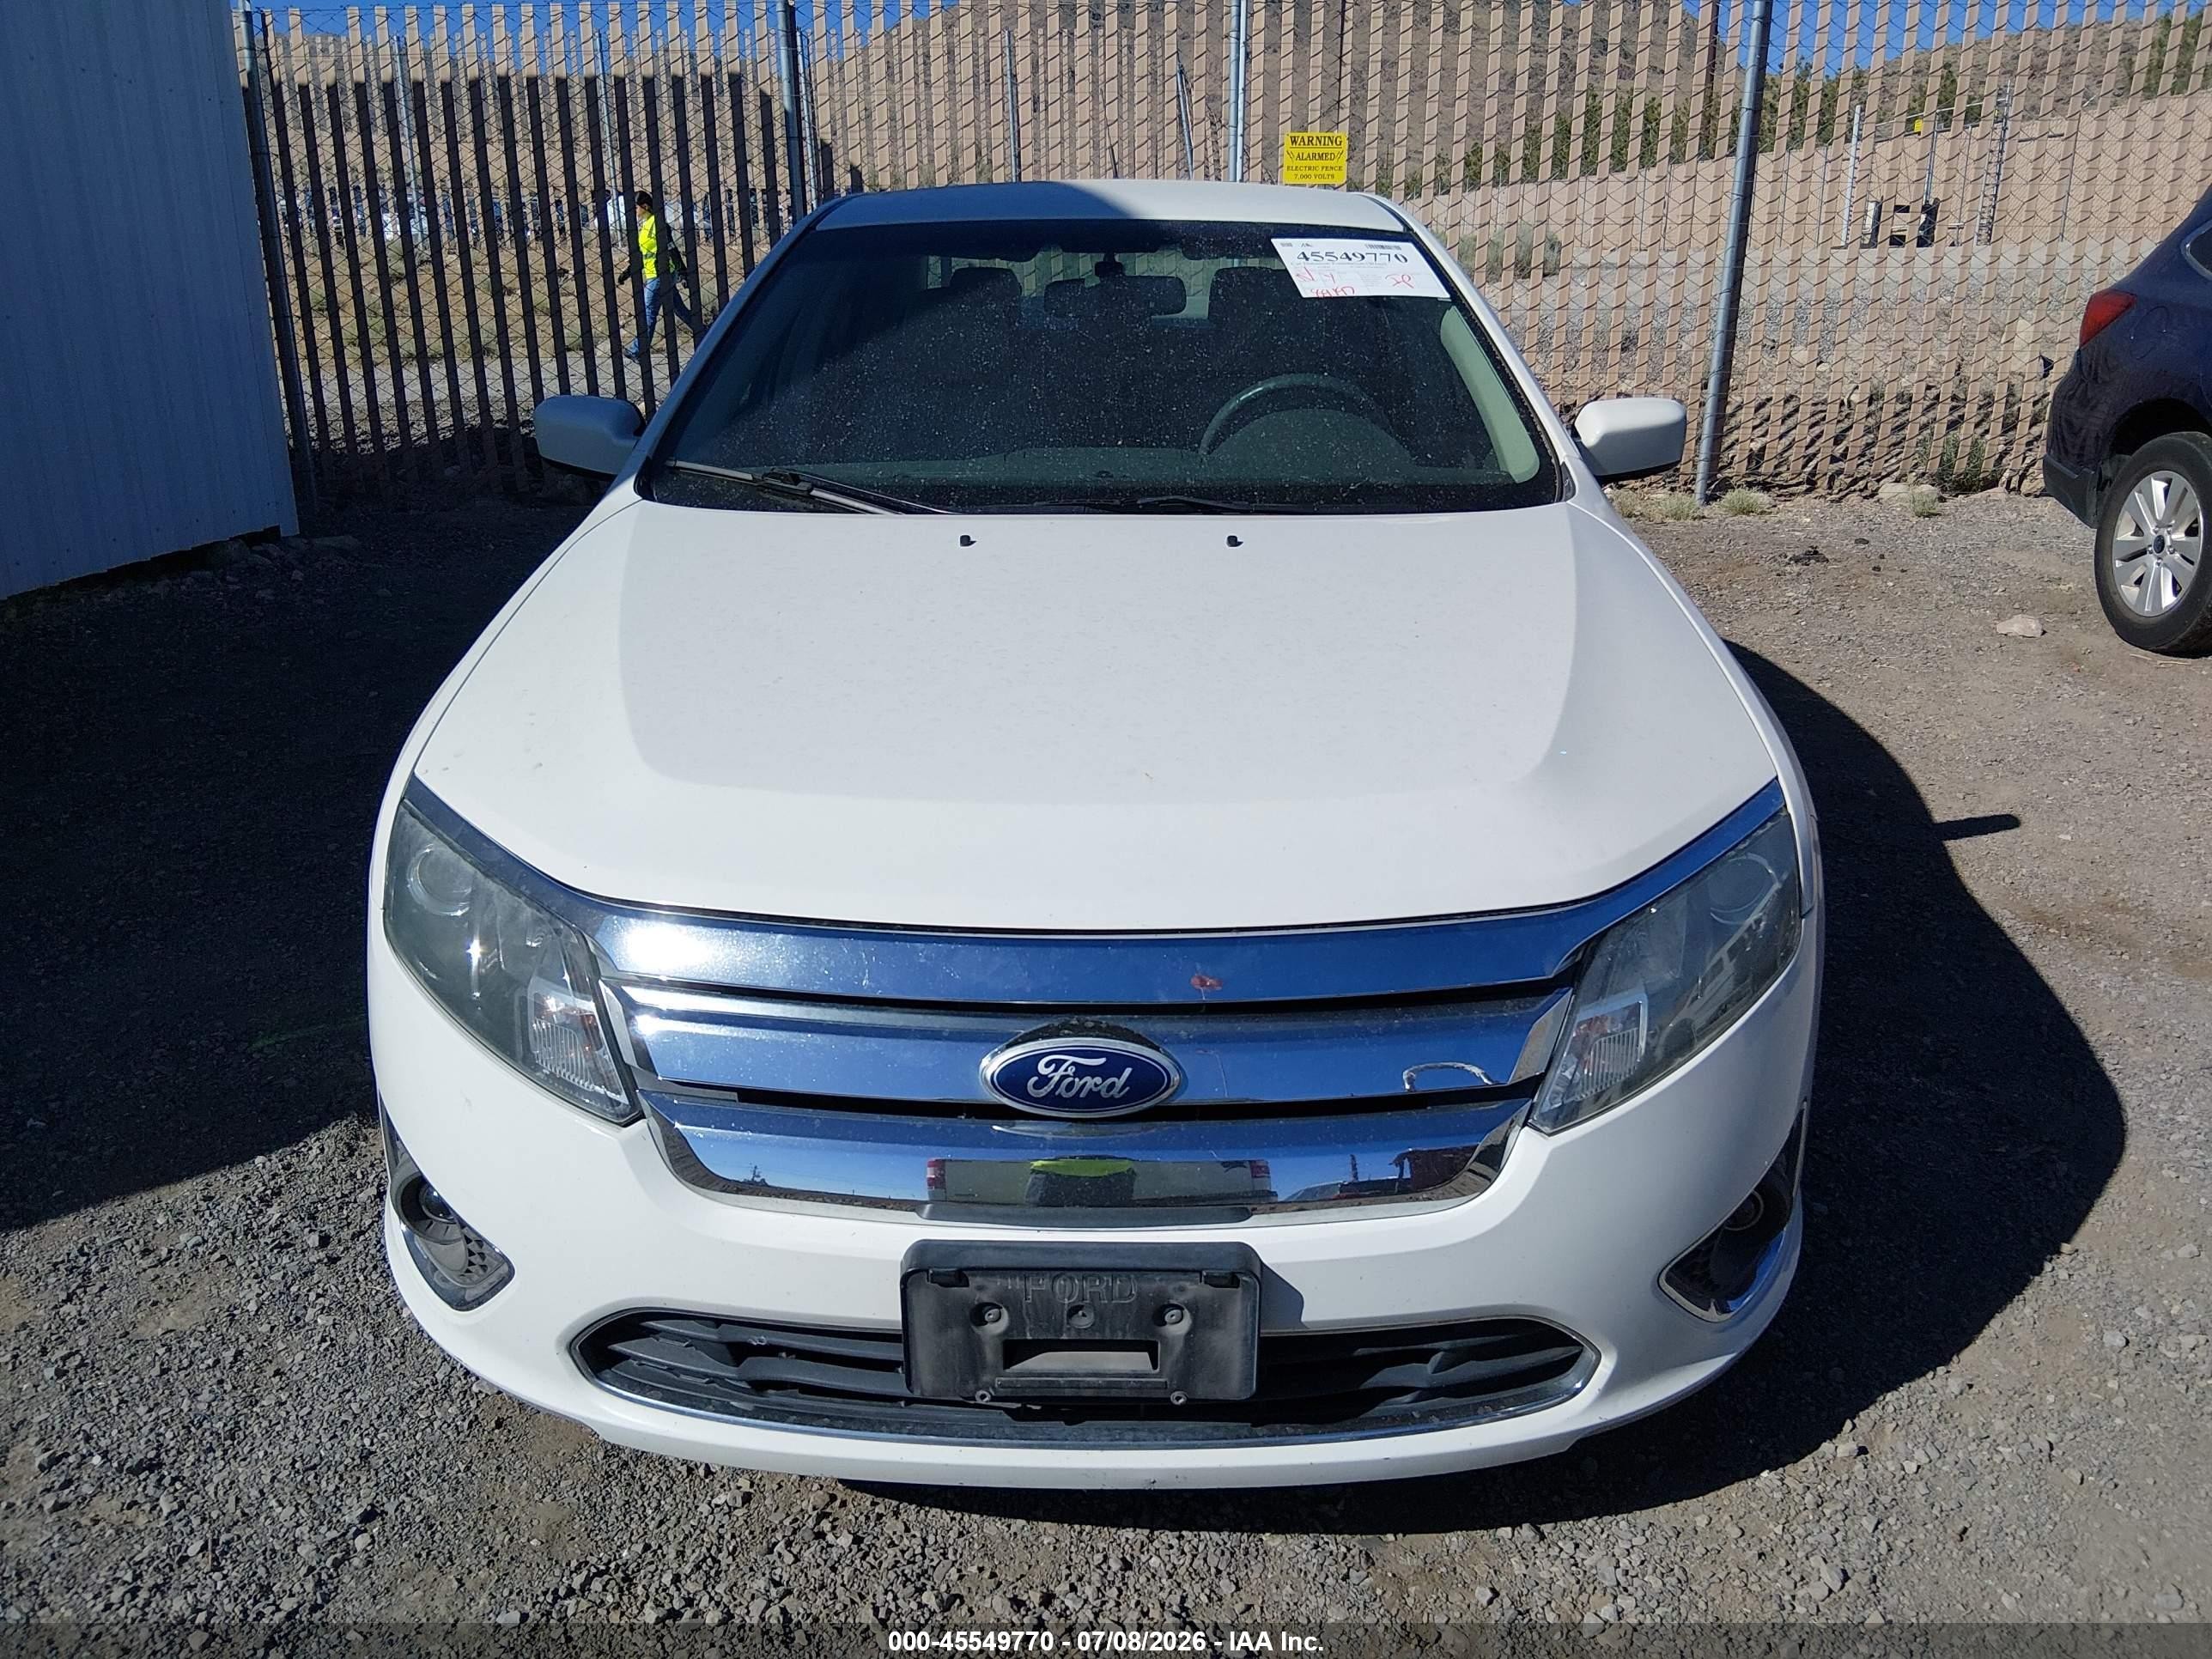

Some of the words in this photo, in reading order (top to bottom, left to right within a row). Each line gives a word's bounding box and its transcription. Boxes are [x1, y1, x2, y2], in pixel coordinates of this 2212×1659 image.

[1290, 135, 1342, 147] WARNING
[1296, 152, 1335, 161] ALARMED
[1297, 251, 1408, 264] 45549770
[1026, 1054, 1133, 1099] Ford
[1024, 1273, 1138, 1304] FORD
